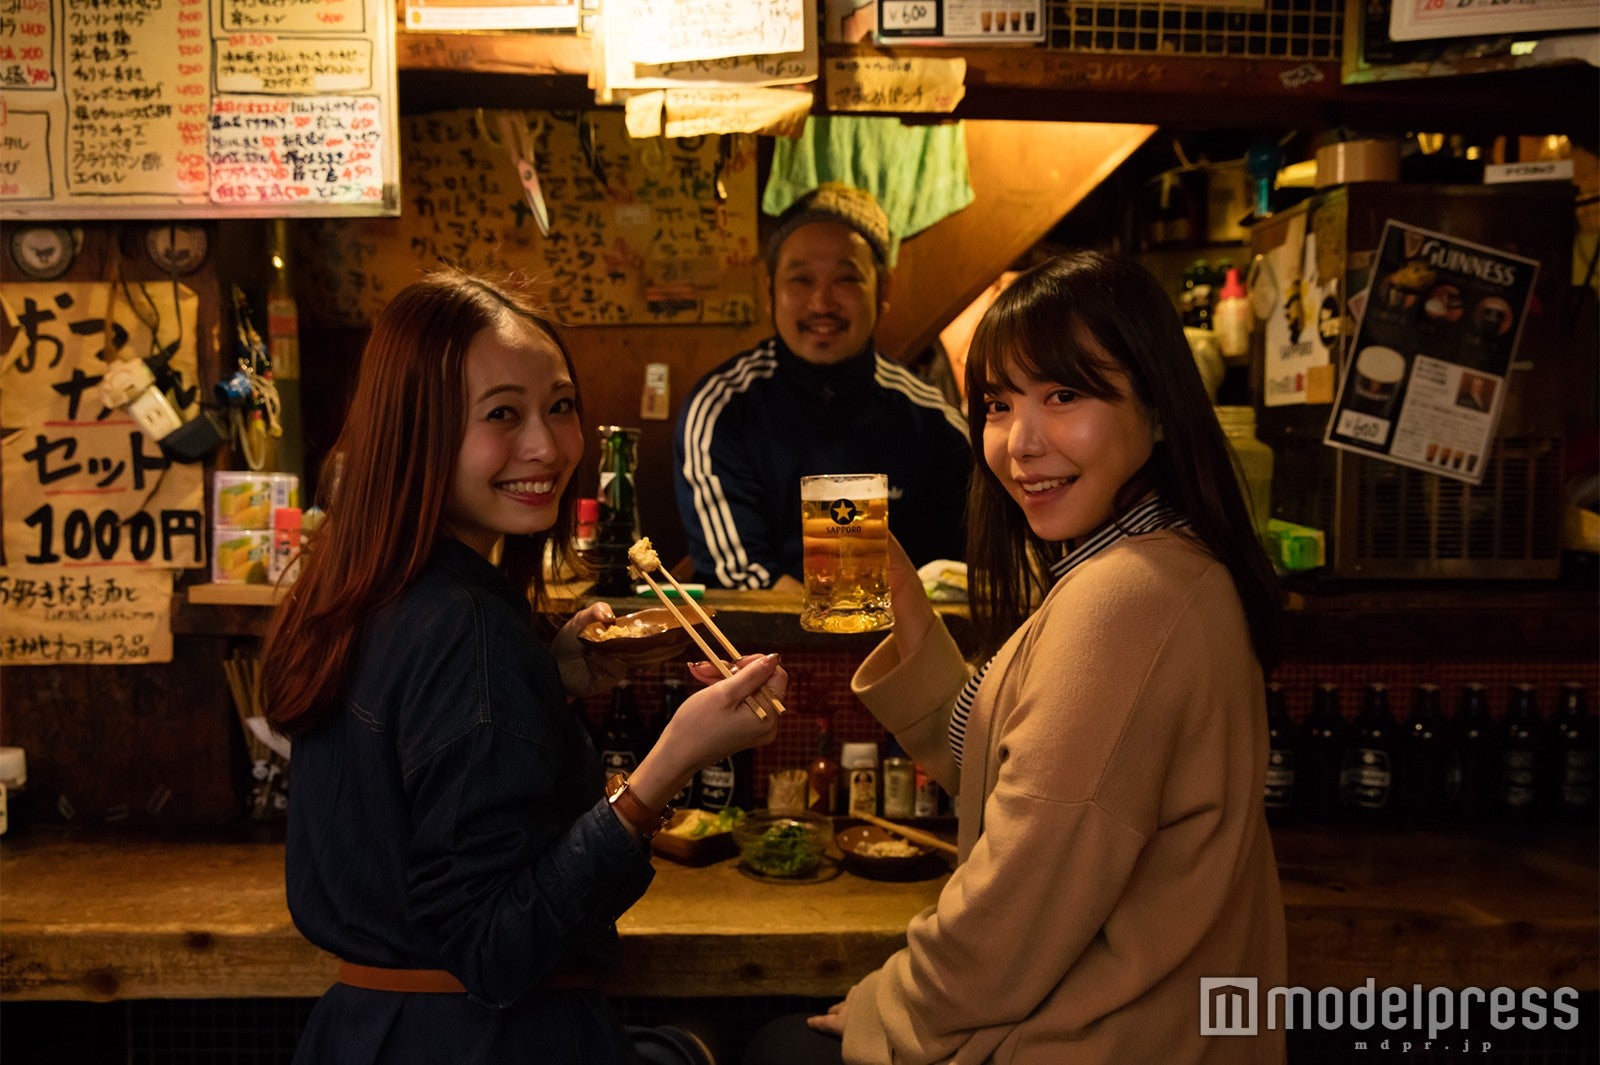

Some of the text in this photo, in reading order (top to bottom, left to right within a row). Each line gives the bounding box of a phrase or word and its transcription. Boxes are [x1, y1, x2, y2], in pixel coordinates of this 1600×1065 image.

[1421, 240, 1517, 287] GUINNESS
[23, 431, 171, 490] セット
[25, 503, 202, 565] 1000円
[826, 526, 862, 535] SAPPORO
[0, 633, 151, 660] まかせおつまみ3品
